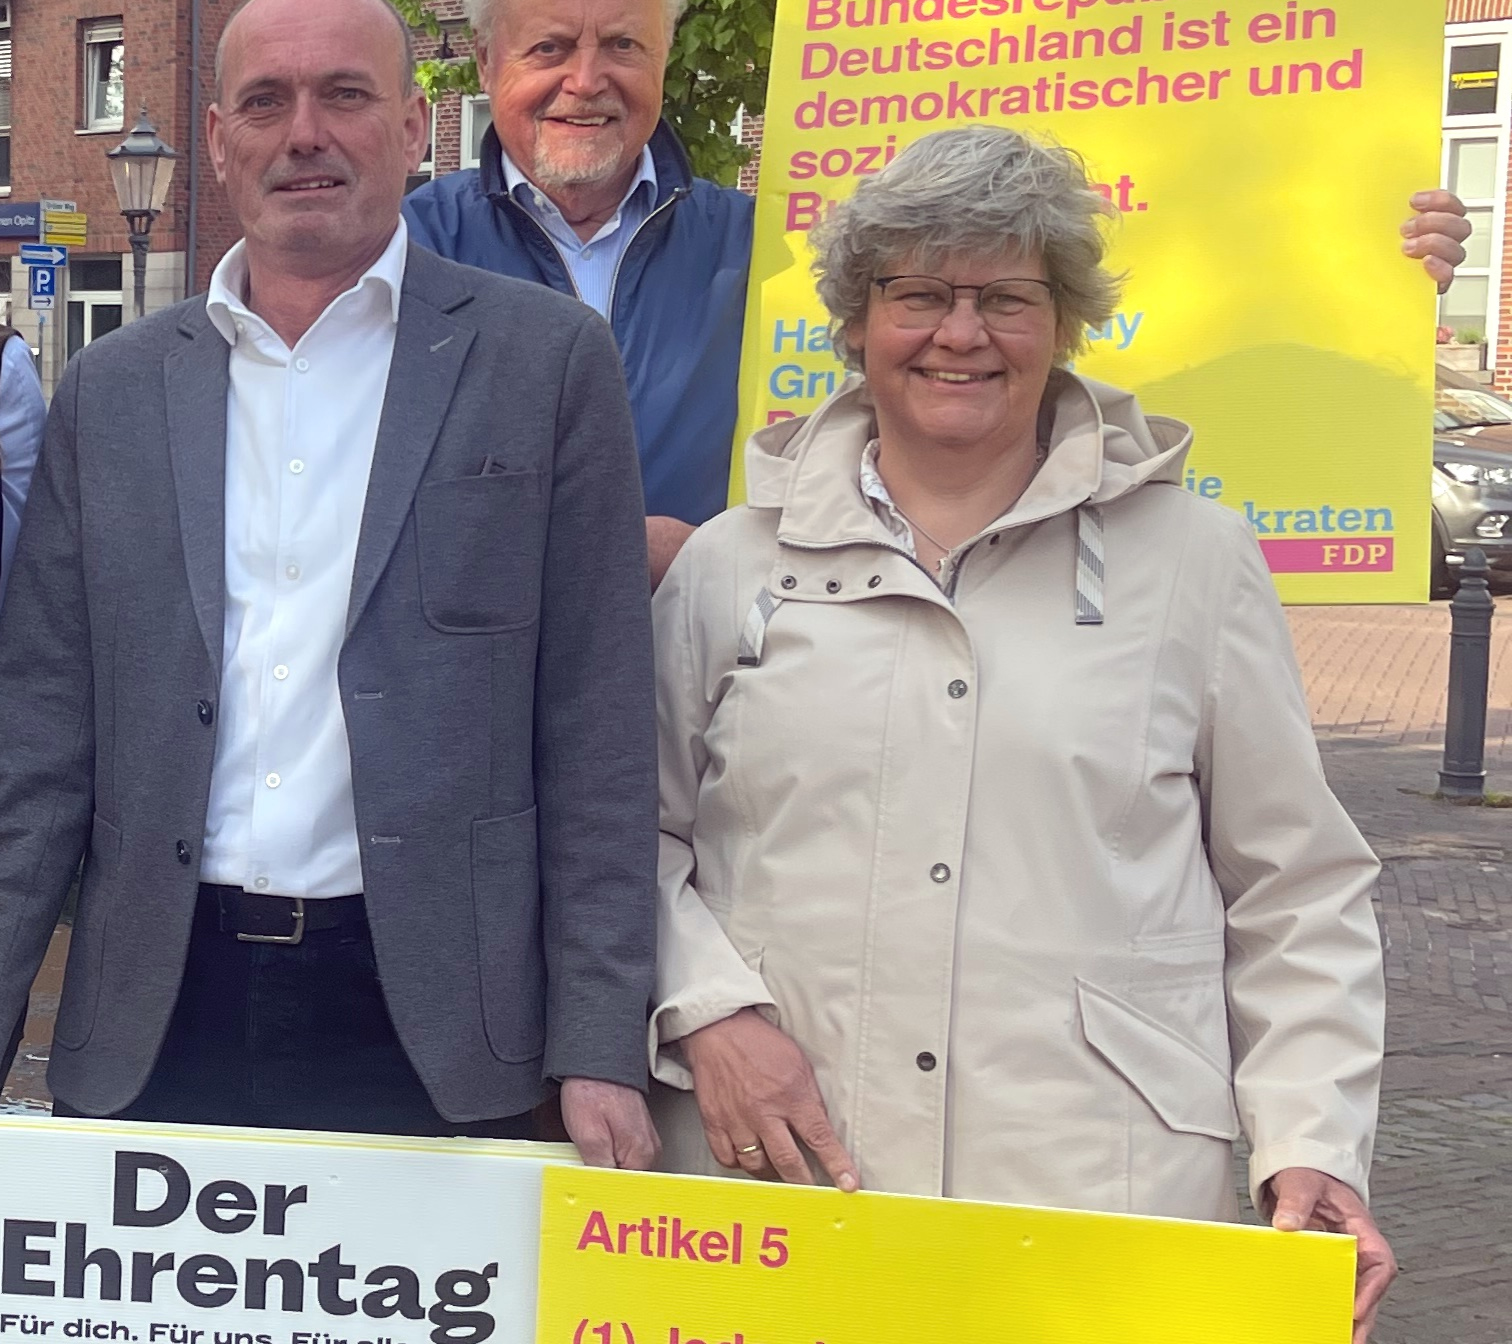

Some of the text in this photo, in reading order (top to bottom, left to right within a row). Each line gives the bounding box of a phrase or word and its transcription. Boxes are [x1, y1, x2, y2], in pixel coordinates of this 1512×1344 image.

[800, 1, 1336, 80] Deutschland ist ein
[794, 48, 1363, 130] demokratischer und
[113, 1151, 307, 1236] Der
[577, 1210, 788, 1268] Artikel 5
[1, 1314, 54, 1335] Für
[63, 1319, 138, 1341] dich.
[150, 1323, 204, 1344] Für
